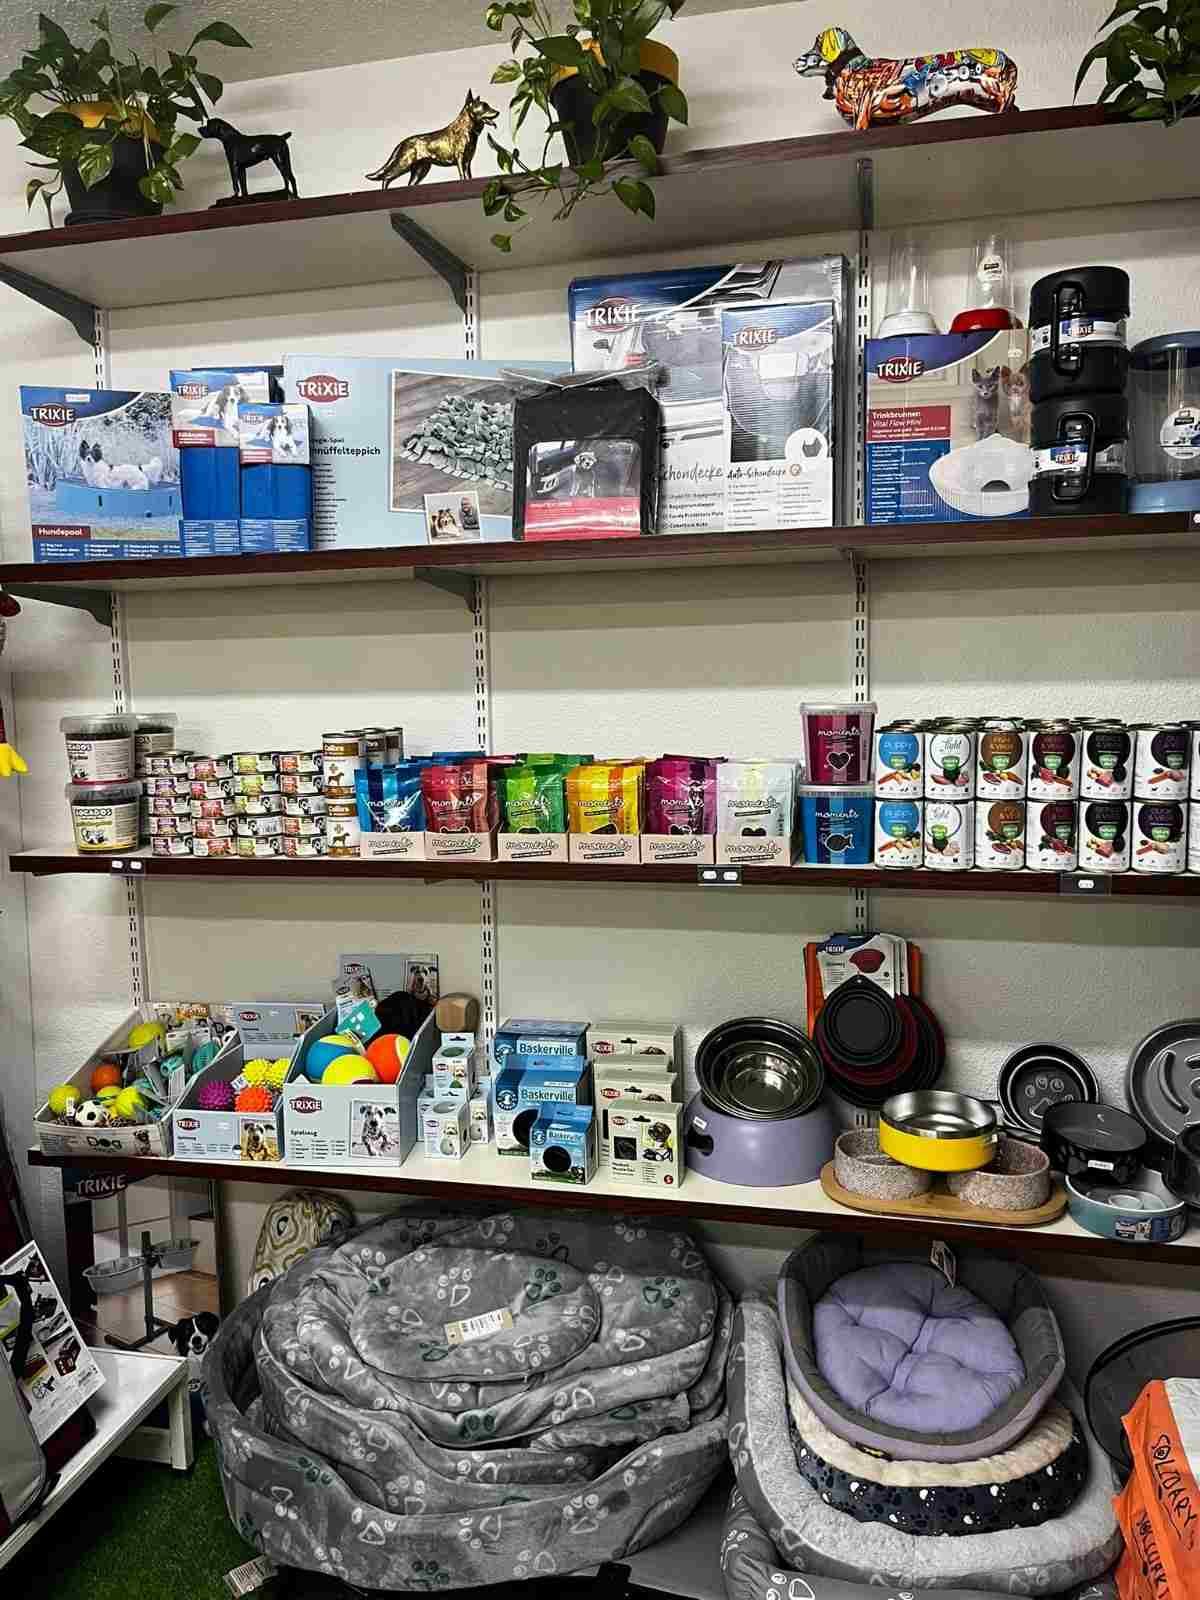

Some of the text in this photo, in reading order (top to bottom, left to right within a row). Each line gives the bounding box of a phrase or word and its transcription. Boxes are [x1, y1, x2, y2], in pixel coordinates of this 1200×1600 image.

[585, 303, 641, 325] TRIXIE
[734, 329, 777, 344] TRIXIE
[877, 361, 922, 376] TRIXIE
[176, 384, 208, 395] TRIXIE
[31, 407, 74, 421] TRIXIE
[660, 462, 723, 484] chondecke
[38, 528, 83, 537] Hundepool
[817, 727, 863, 737] moments
[815, 809, 859, 818] moments
[519, 1044, 575, 1056] Baskerville
[521, 1088, 575, 1101] Baskerville
[75, 1174, 127, 1194] TRIXIE
